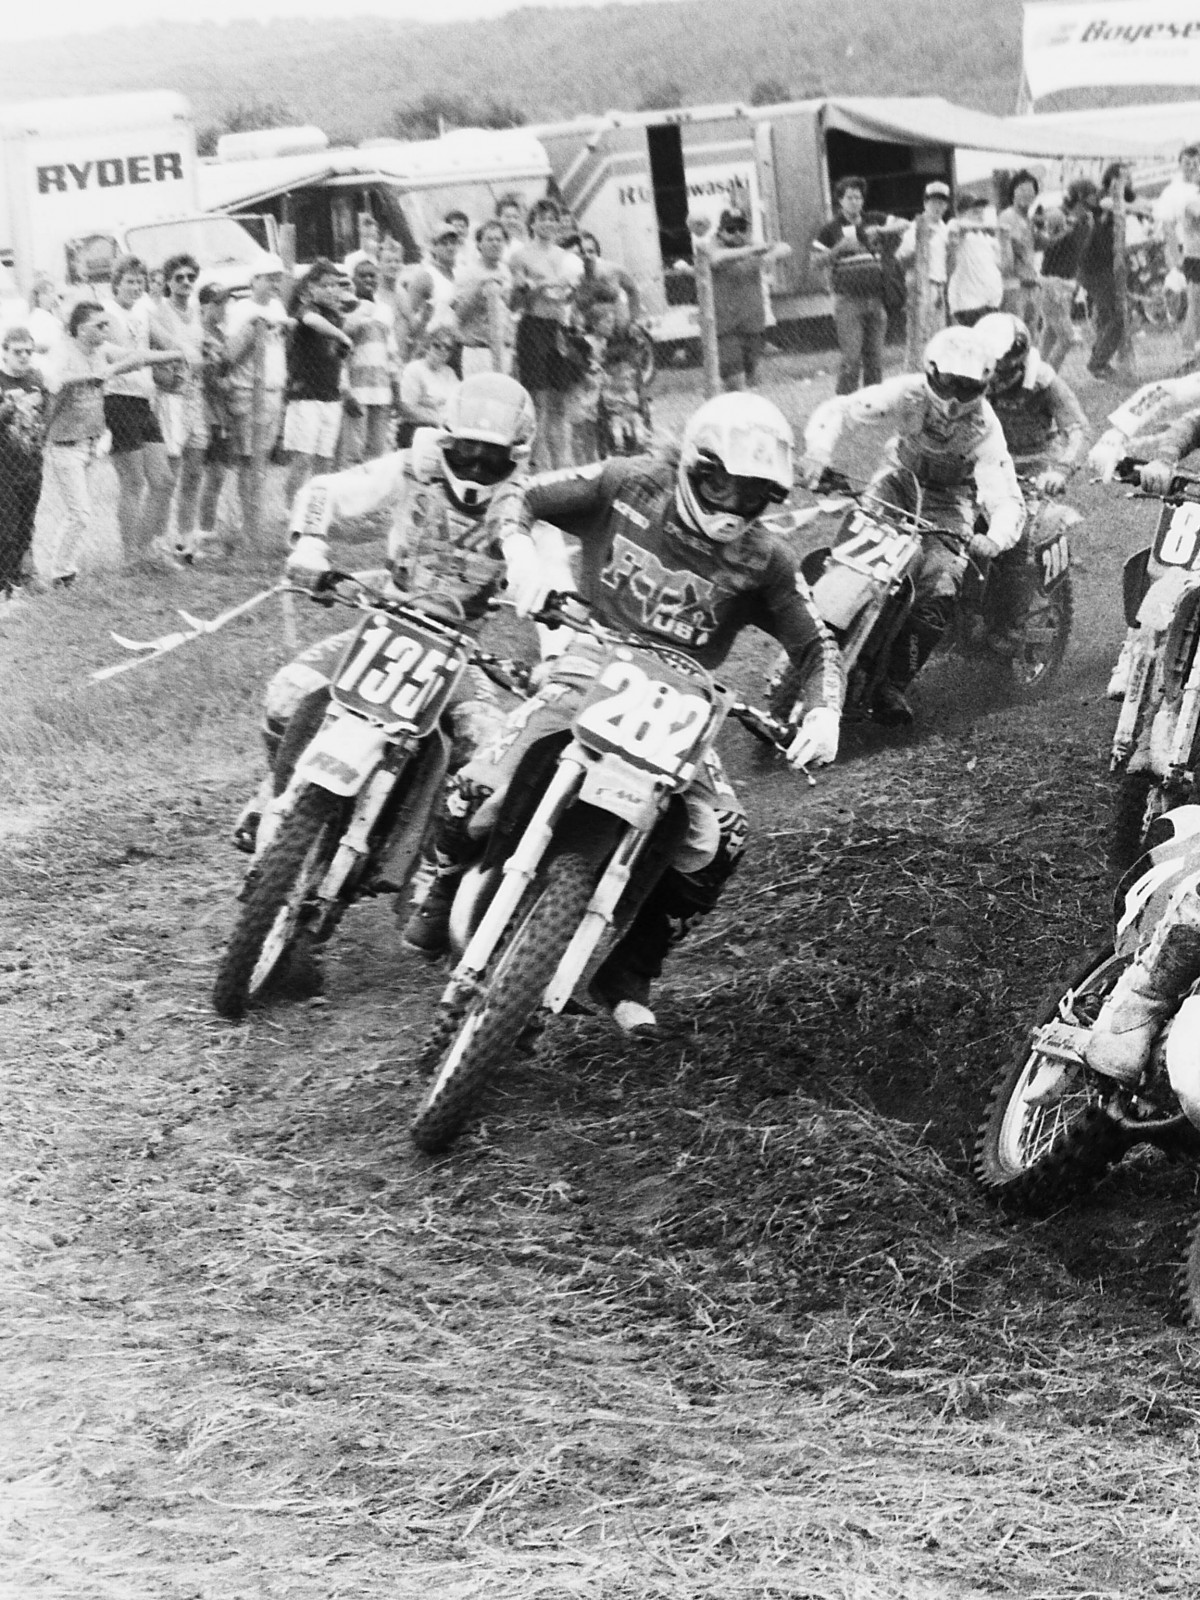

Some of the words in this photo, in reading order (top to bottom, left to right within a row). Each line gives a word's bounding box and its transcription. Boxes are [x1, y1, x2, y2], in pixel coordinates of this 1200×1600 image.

[36, 152, 184, 194] RYDER
[337, 626, 460, 719] 135
[576, 662, 711, 780] 282
